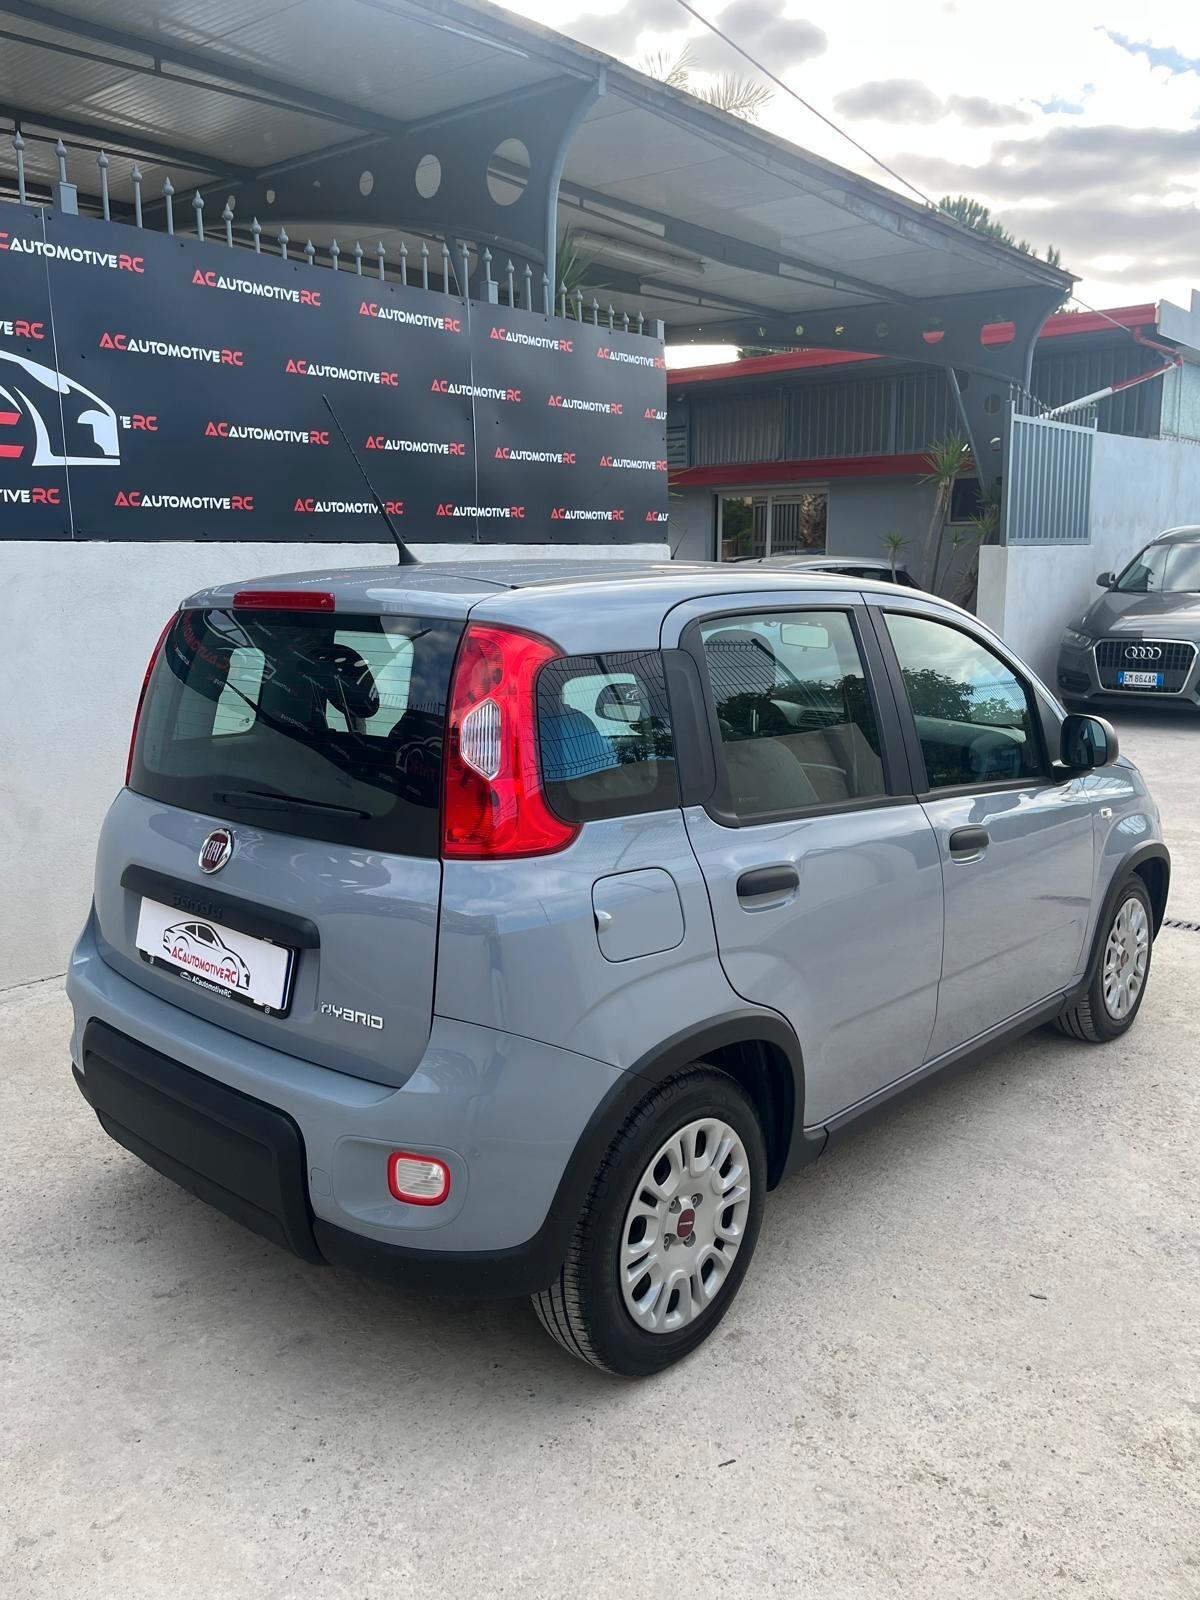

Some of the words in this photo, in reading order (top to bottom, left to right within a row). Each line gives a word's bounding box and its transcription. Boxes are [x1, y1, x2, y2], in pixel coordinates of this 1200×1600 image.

[192, 270, 321, 306] ACAUTOMOTIVERC
[360, 302, 460, 332] ACAUTOMOTIVERC
[100, 333, 244, 366] ACAUTOMOTIVERC
[490, 328, 573, 352] ACAUTOMOTIVERC
[286, 359, 398, 386] ACAUTOMOTIVERC
[431, 379, 521, 402] ACAUTOMOTIVERC
[549, 396, 622, 414] ACAUTOMOTIVERC
[120, 415, 158, 431] ERC
[205, 422, 329, 444] ACAUTOMOTIVERC
[366, 436, 465, 455] ACAUTOMOTIVERC
[495, 448, 575, 464] ACAUTOMOTIVERC
[115, 491, 253, 510] ACAUTOMOTIVERC
[294, 499, 404, 514] ACAUTOMOTIVRC
[436, 504, 525, 518] ACAUTOMOTIVERC
[551, 508, 624, 520] ACAUTOMOTIVERC
[203, 840, 226, 862] FIAT
[321, 1001, 384, 1030] HYBRID
